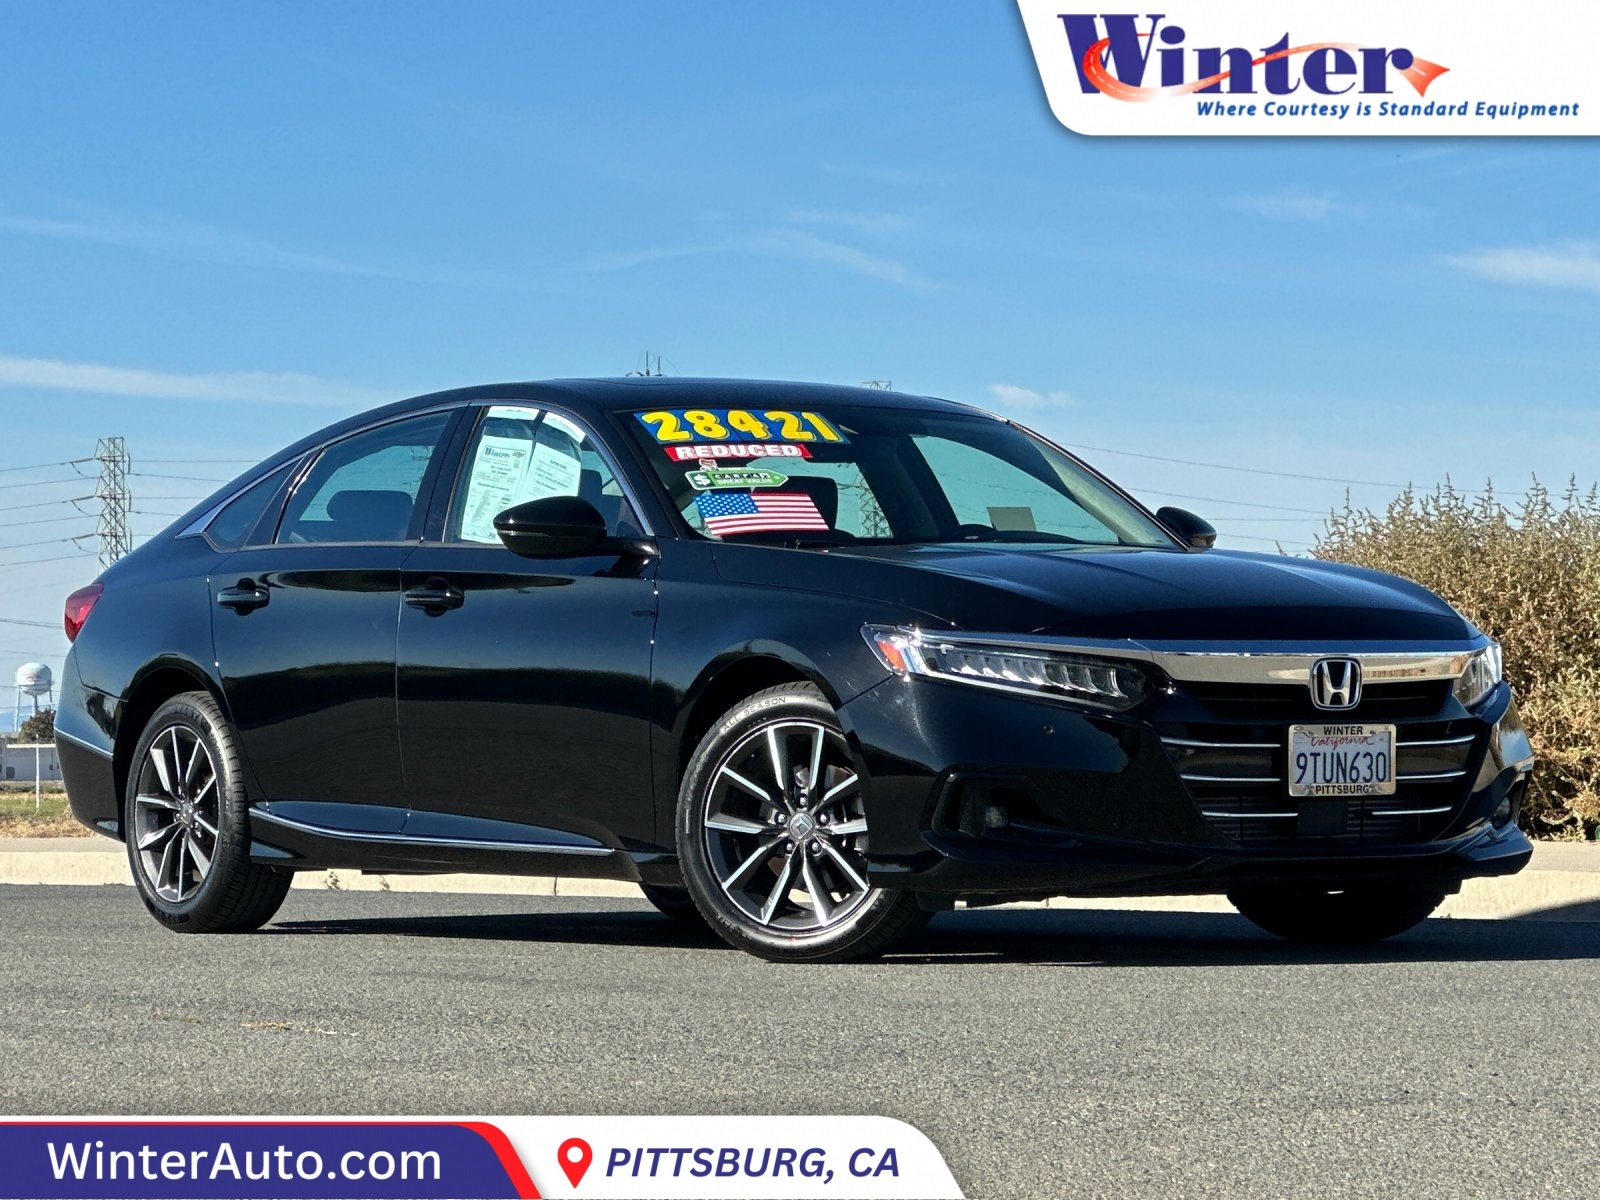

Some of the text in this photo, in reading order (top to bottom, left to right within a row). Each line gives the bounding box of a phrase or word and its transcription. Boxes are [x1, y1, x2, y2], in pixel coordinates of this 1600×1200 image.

[641, 410, 842, 442] 28421
[675, 444, 803, 460] REDUCED
[743, 697, 786, 716] SEASON
[1323, 726, 1364, 735] WINTER
[1310, 735, 1374, 751] California
[1295, 751, 1387, 784] 9TUN630
[1315, 784, 1370, 794] PITTSBURG
